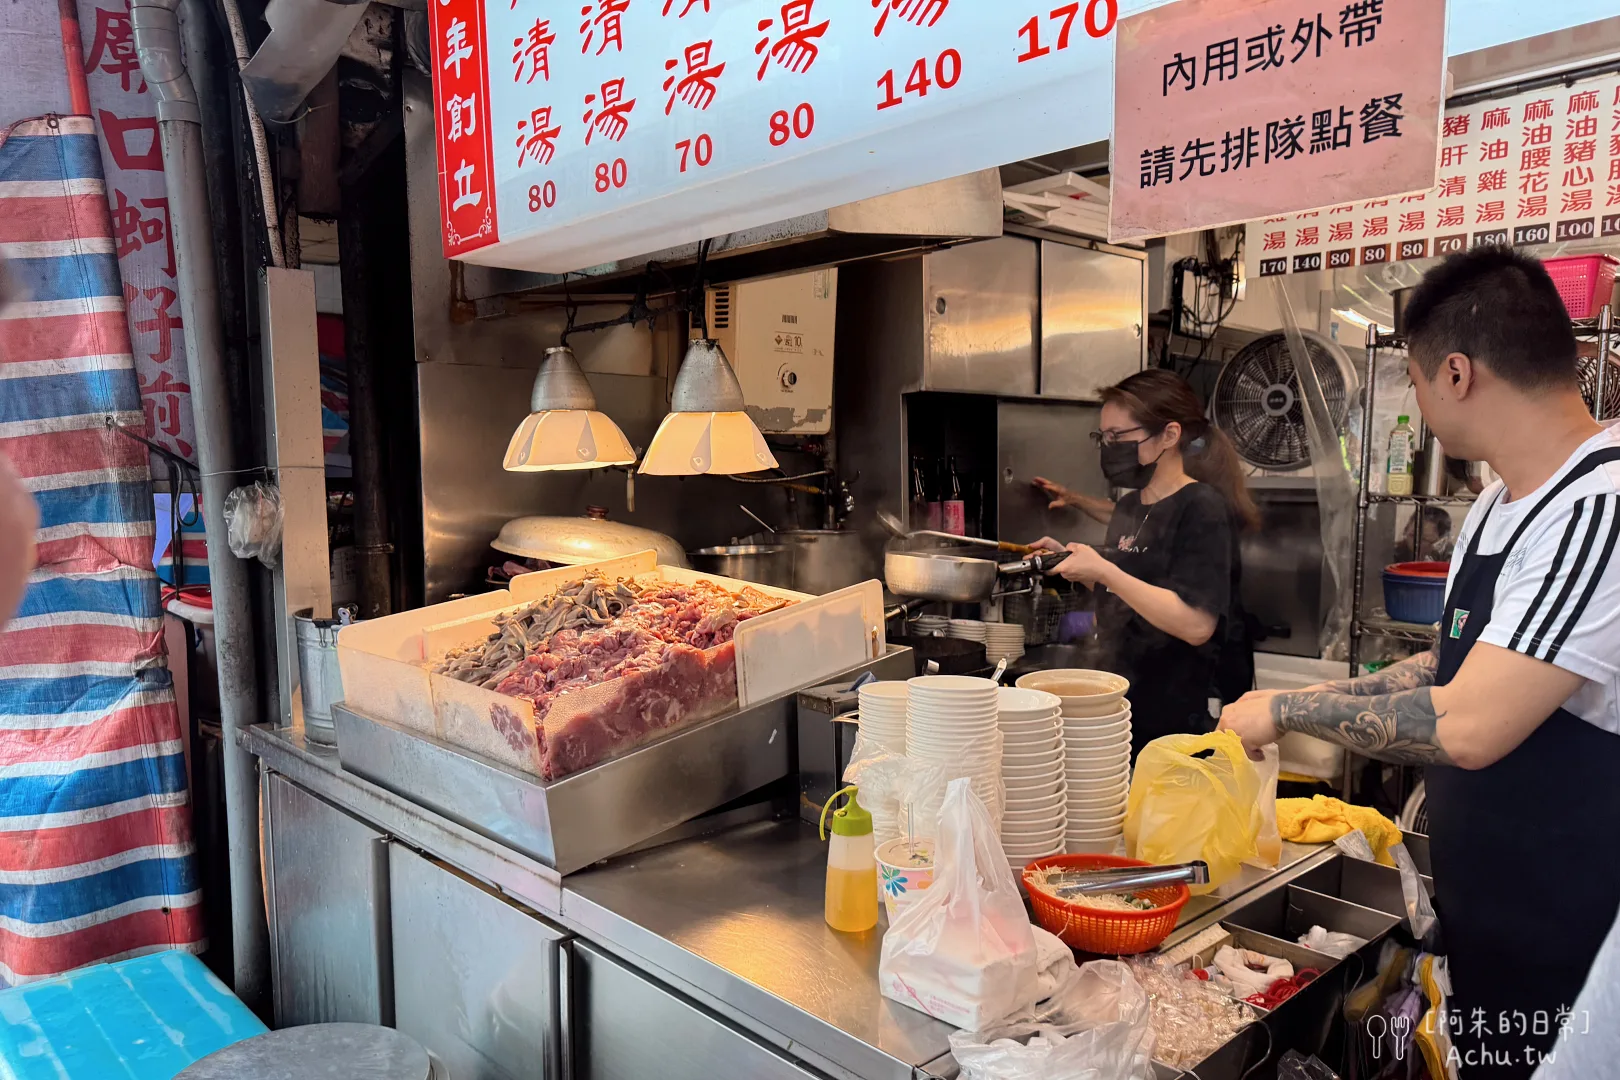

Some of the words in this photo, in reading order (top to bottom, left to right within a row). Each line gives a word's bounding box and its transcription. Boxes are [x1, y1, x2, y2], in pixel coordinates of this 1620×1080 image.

[754, 0, 831, 81] 湯
[1017, 0, 1119, 63] 170
[1161, 0, 1383, 97] 內用或外帶
[661, 0, 727, 116] 湯
[510, 0, 562, 168] 清湯
[876, 48, 962, 111] 140
[440, 0, 483, 212] 年創立
[768, 102, 815, 147] 80
[675, 133, 713, 173] 70
[1139, 92, 1405, 189] 請先排隊點餐
[1516, 99, 1554, 219] 麻油腰花湯
[1560, 90, 1600, 214] 麻油豬心湯
[594, 158, 628, 193] 80
[1436, 114, 1471, 229] 豬肝清湯
[1475, 107, 1512, 224] 麻油雞湯
[528, 180, 557, 213] 80
[1263, 217, 1287, 251] 湯
[1295, 211, 1320, 247] 湯
[1401, 242, 1424, 257] 80
[1439, 238, 1462, 253] 70
[1516, 227, 1549, 243] 160
[1557, 221, 1594, 237] 100
[1260, 260, 1287, 275] 170
[1293, 255, 1321, 270] 140
[1330, 251, 1350, 266] 80
[1364, 247, 1386, 262] 80
